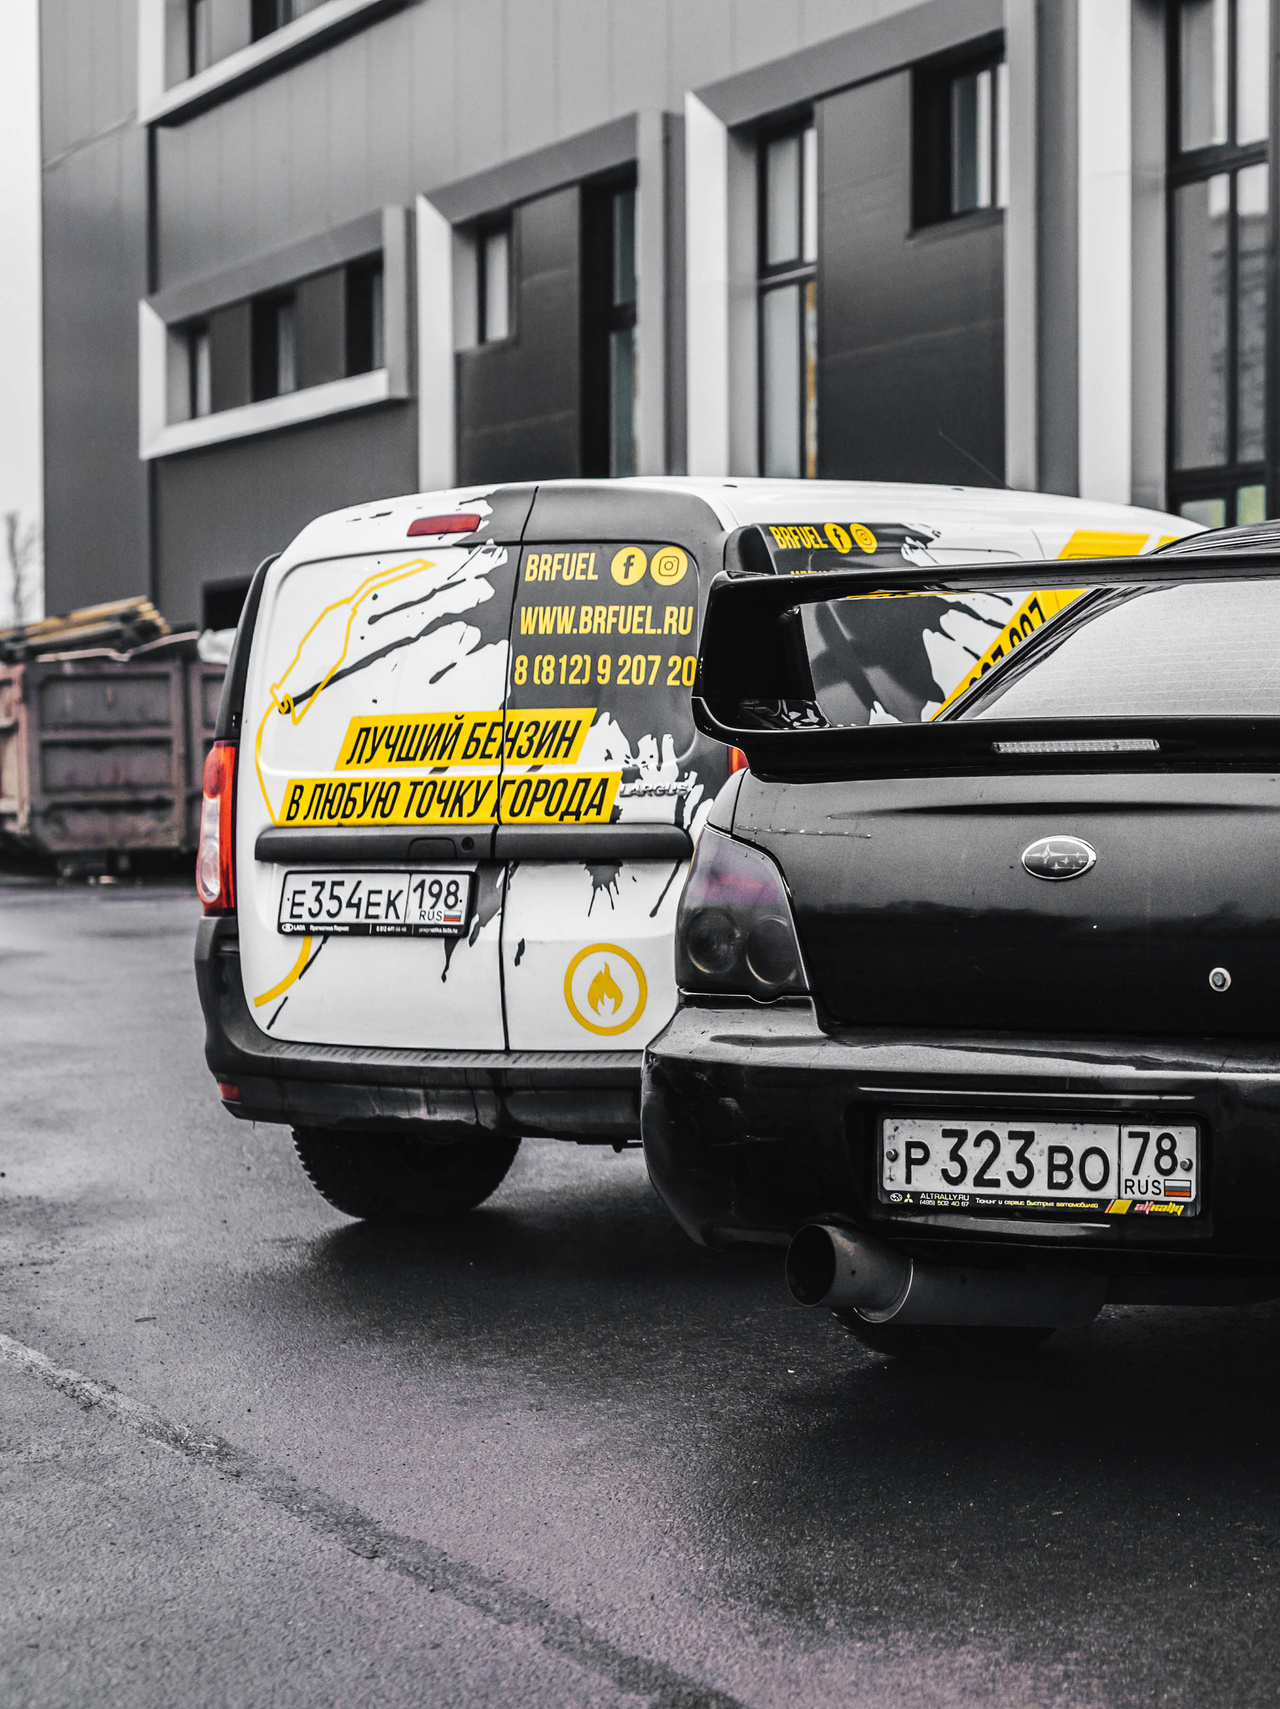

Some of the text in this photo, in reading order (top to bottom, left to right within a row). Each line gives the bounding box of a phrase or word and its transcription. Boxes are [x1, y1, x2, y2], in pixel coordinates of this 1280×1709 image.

[769, 526, 828, 549] BRFUEL
[524, 552, 599, 582] BRFUEL
[520, 605, 694, 635] WWW.BRFUEL.RU
[514, 654, 529, 685] 8
[533, 654, 592, 685] (812)
[596, 654, 612, 684] 9
[616, 654, 662, 685] 207
[345, 714, 582, 765] ЛУЧШИЙ БЕНЗИН
[286, 777, 610, 823] В ЛЮБУЮ ТОЧКУ ГОРОДА
[412, 879, 460, 910] 198
[418, 911, 443, 923] RUS
[1128, 1131, 1179, 1176] 78
[920, 1193, 970, 1202] ALTRALLY.RU
[1124, 1179, 1162, 1197] RUS
